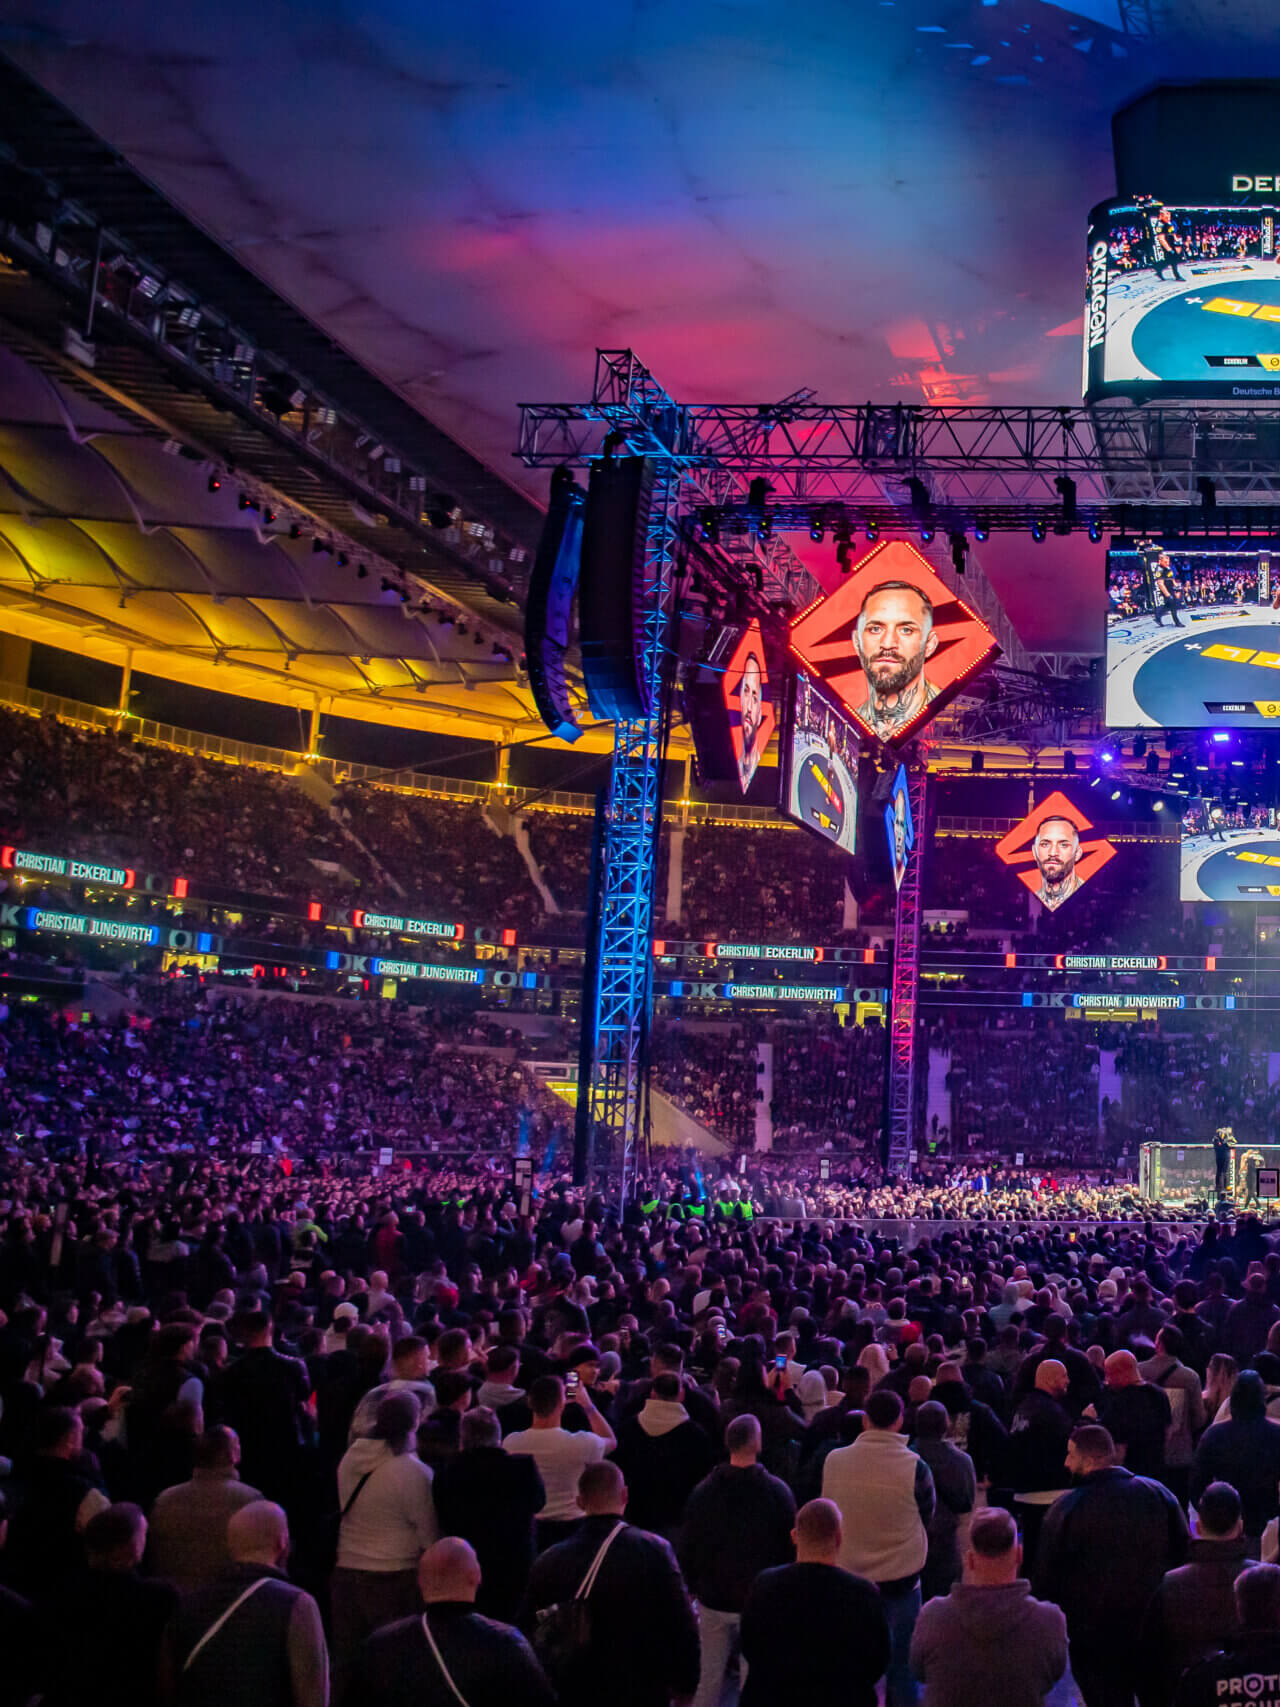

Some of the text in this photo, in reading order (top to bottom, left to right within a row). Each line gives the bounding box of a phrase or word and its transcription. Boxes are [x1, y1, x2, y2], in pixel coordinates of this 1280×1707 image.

[1090, 241, 1108, 348] OKTAGON
[1232, 387, 1272, 396] Deutsche
[16, 852, 125, 885] CHRISTIAN ECKERLIN
[36, 912, 86, 932] CHRISTIAN
[90, 920, 152, 942] JUNGWIRTH
[364, 914, 455, 937] CHRISTIAN ECKERLIN
[717, 944, 815, 960] CHRISTIAN ECKERLIN
[378, 961, 417, 976] CHRISTIAN
[421, 966, 477, 982] JUNGWIRTH
[1065, 957, 1158, 969] CHRISTIAN ECKERLIN
[731, 985, 774, 999] CHRISTIAN
[778, 986, 837, 1000] JUNGWIRTH
[1079, 995, 1119, 1007] CHRISTIAN
[1124, 996, 1180, 1007] JUNGWIRTH
